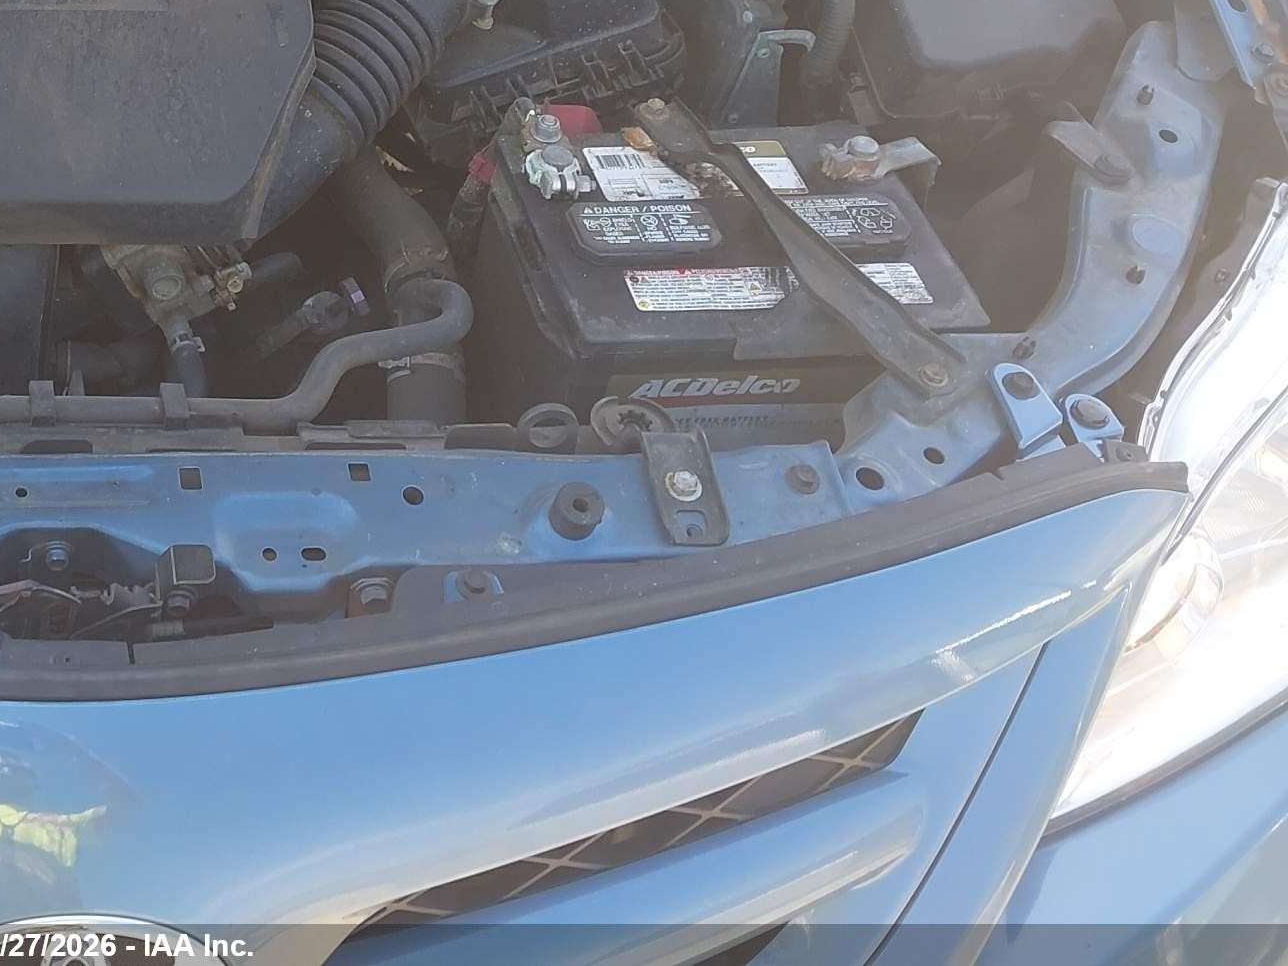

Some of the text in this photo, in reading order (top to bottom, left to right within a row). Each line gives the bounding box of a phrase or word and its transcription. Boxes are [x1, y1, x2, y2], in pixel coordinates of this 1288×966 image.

[594, 206, 640, 214] DANGER
[650, 204, 691, 212] POISON
[629, 376, 800, 399] ACDelco
